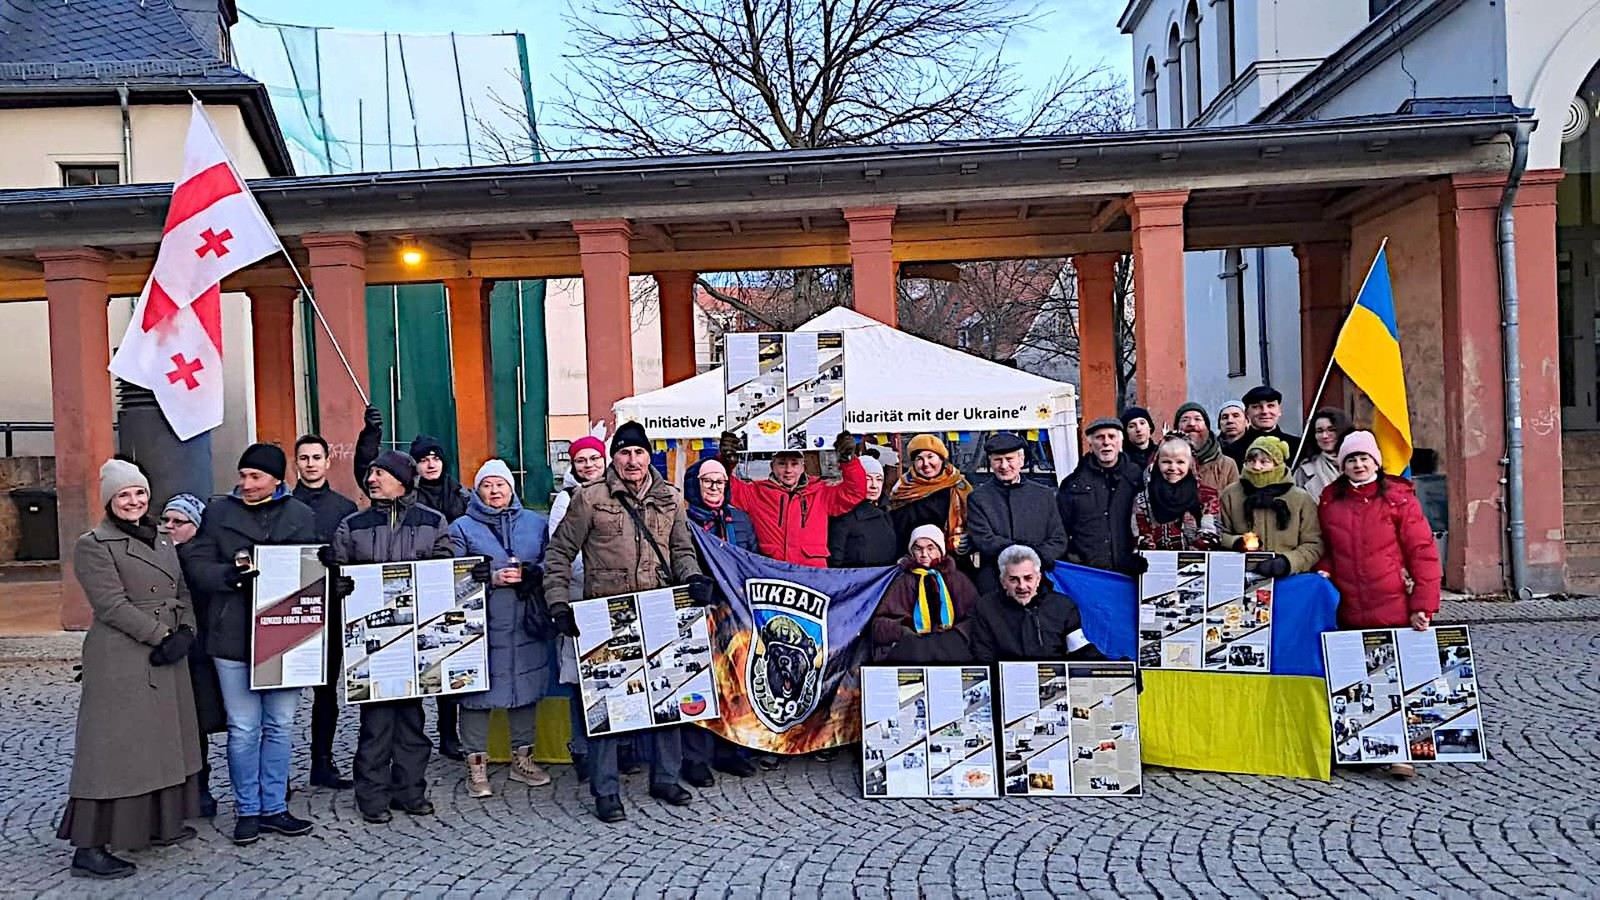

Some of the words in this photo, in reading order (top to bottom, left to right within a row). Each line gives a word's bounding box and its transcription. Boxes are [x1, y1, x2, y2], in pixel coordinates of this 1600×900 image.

[644, 415, 706, 429] Initiative
[844, 410, 904, 424] lidarität
[907, 408, 932, 422] mit
[935, 407, 960, 421] der
[963, 405, 1027, 420] Ukraine“
[751, 584, 824, 616] ШКВАЛ
[768, 696, 799, 720] 59
